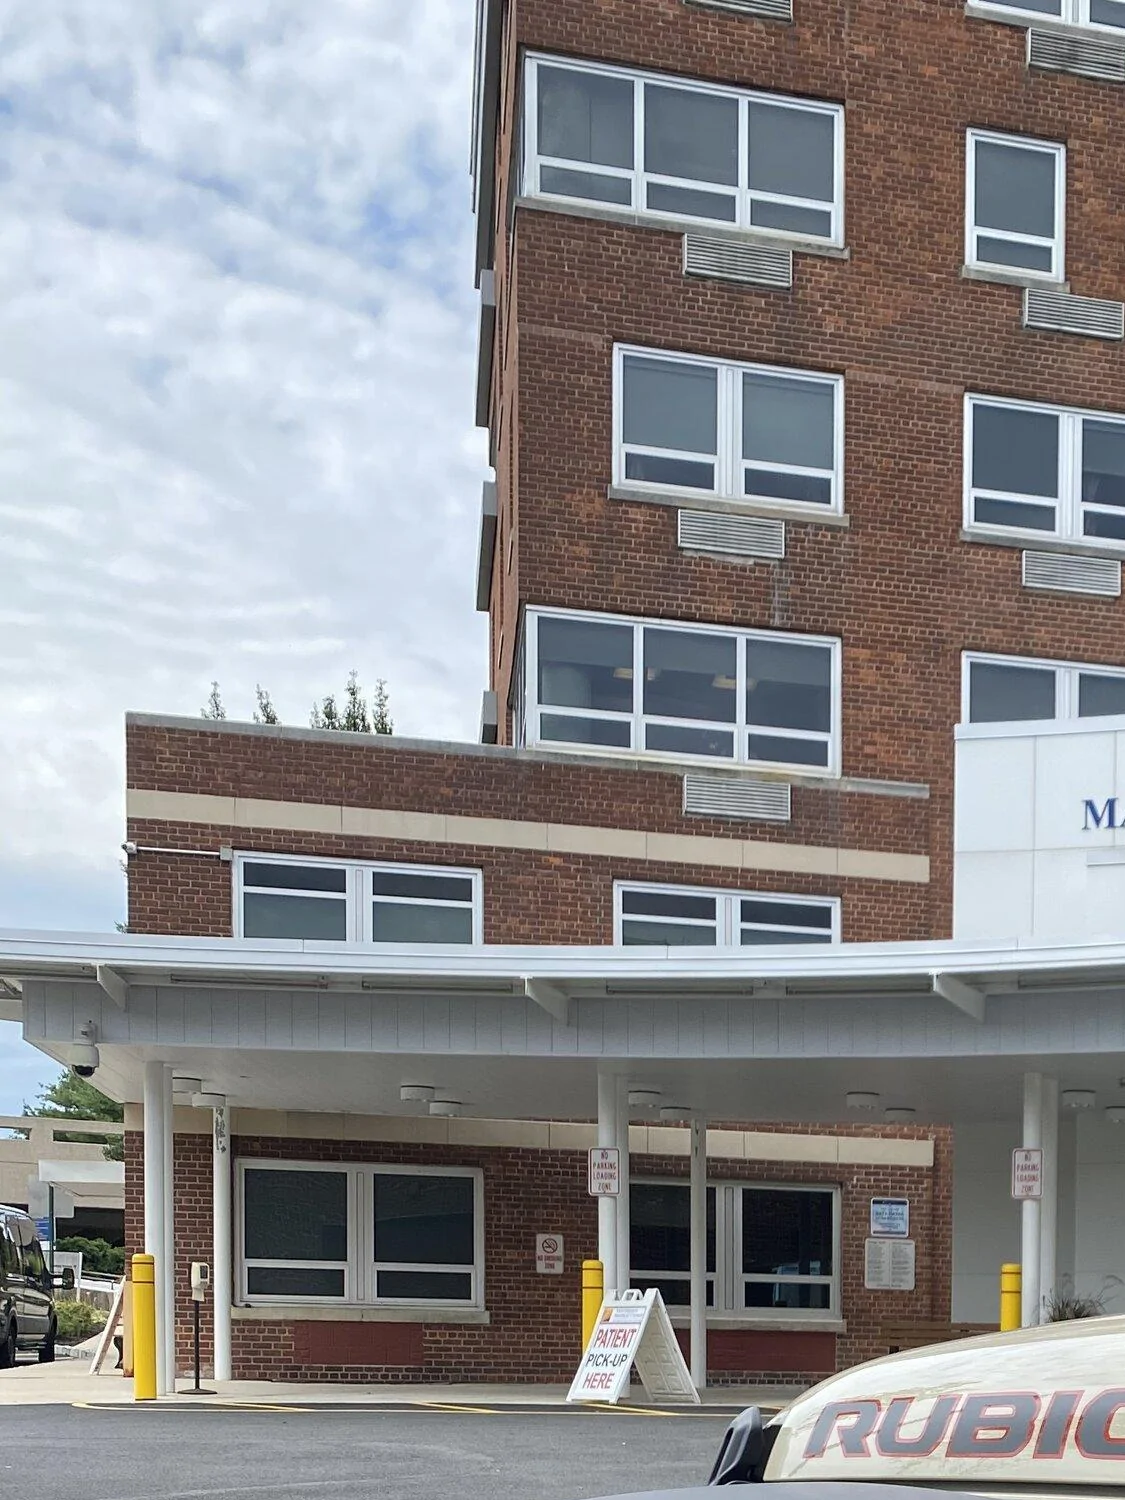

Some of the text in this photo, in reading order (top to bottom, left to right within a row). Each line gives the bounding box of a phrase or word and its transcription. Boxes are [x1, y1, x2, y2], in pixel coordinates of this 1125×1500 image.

[593, 1162, 617, 1170] PARKING
[594, 1328, 637, 1349] PATIENT
[586, 1353, 628, 1368] PICK-UP
[582, 1372, 615, 1389] HERE
